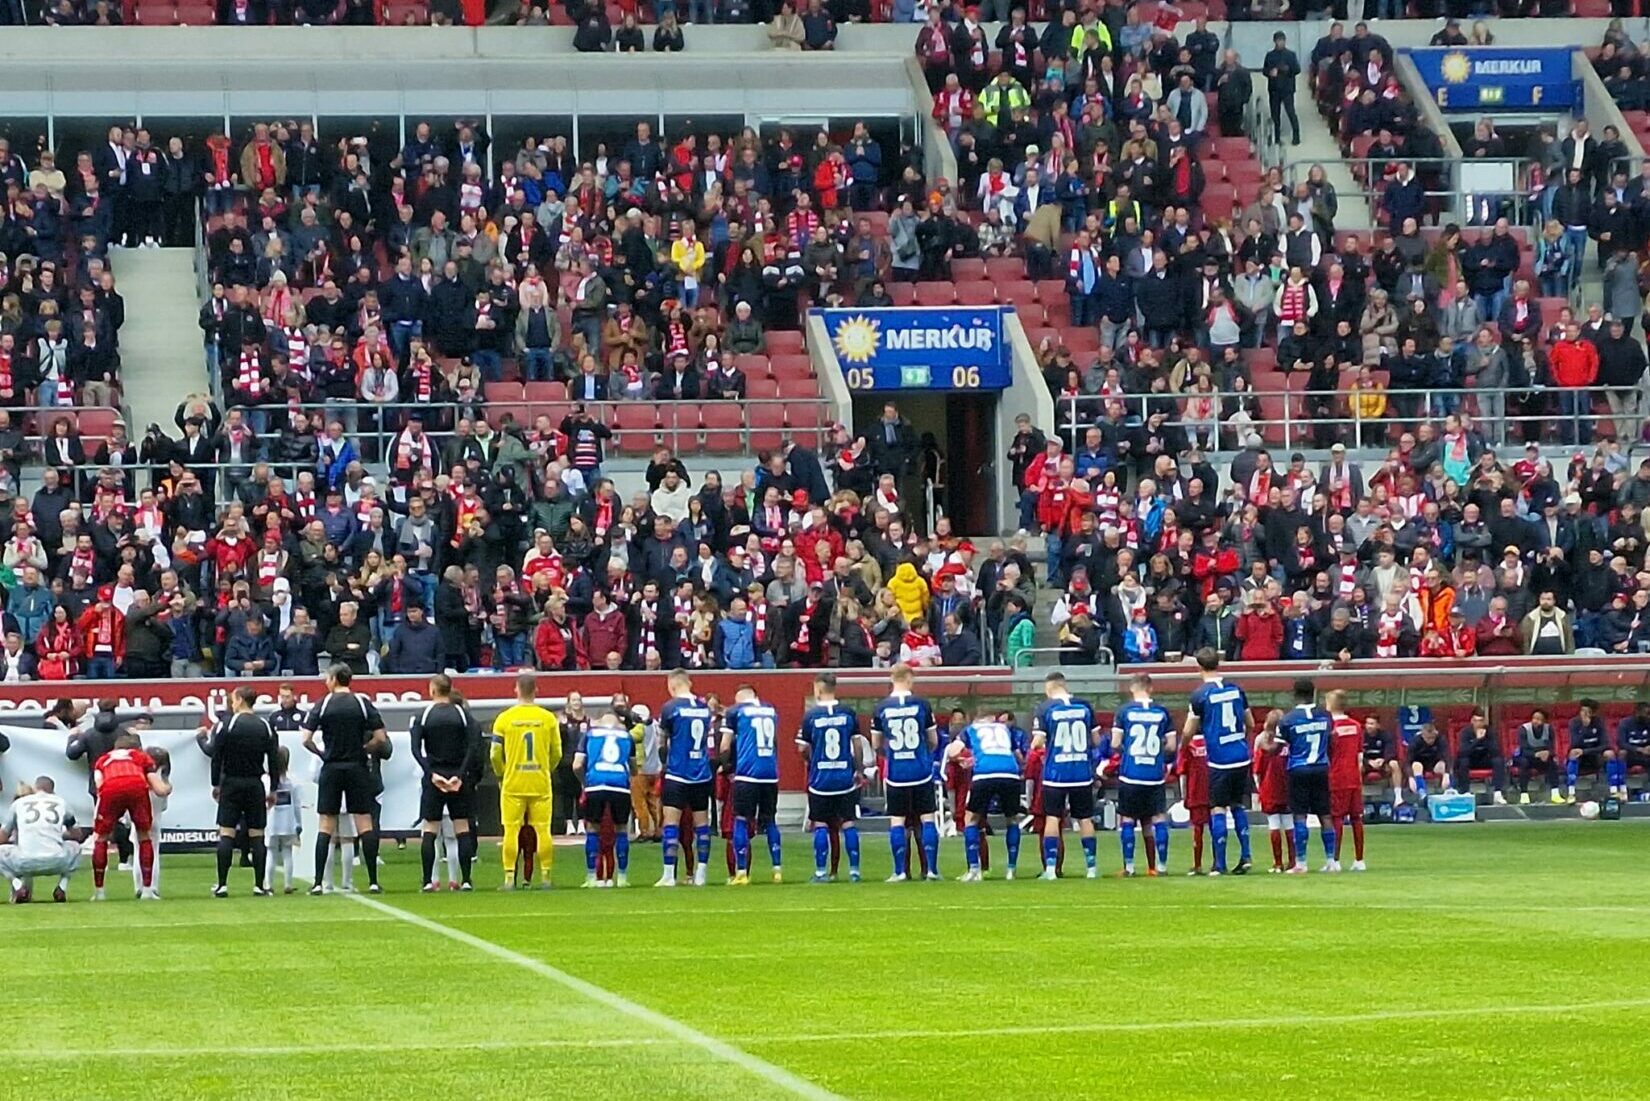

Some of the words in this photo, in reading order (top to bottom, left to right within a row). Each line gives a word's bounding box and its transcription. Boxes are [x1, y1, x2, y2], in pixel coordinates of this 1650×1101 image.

[1475, 59, 1542, 74] MERKUR
[1438, 87, 1447, 105] E
[1533, 86, 1542, 104] F
[886, 328, 992, 350] MERKUR
[848, 368, 875, 389] 05
[953, 366, 980, 388] 06
[1222, 702, 1237, 733] 4
[523, 731, 535, 763] 1
[691, 719, 704, 750] 9
[752, 717, 775, 748] 19
[824, 728, 840, 760] 8
[888, 718, 920, 751] 38
[1054, 720, 1088, 753] 40
[1129, 724, 1160, 756] 26
[603, 735, 620, 763] 6
[1306, 733, 1321, 764] 7
[23, 801, 60, 824] 33
[159, 831, 221, 843] UNDESLIG
